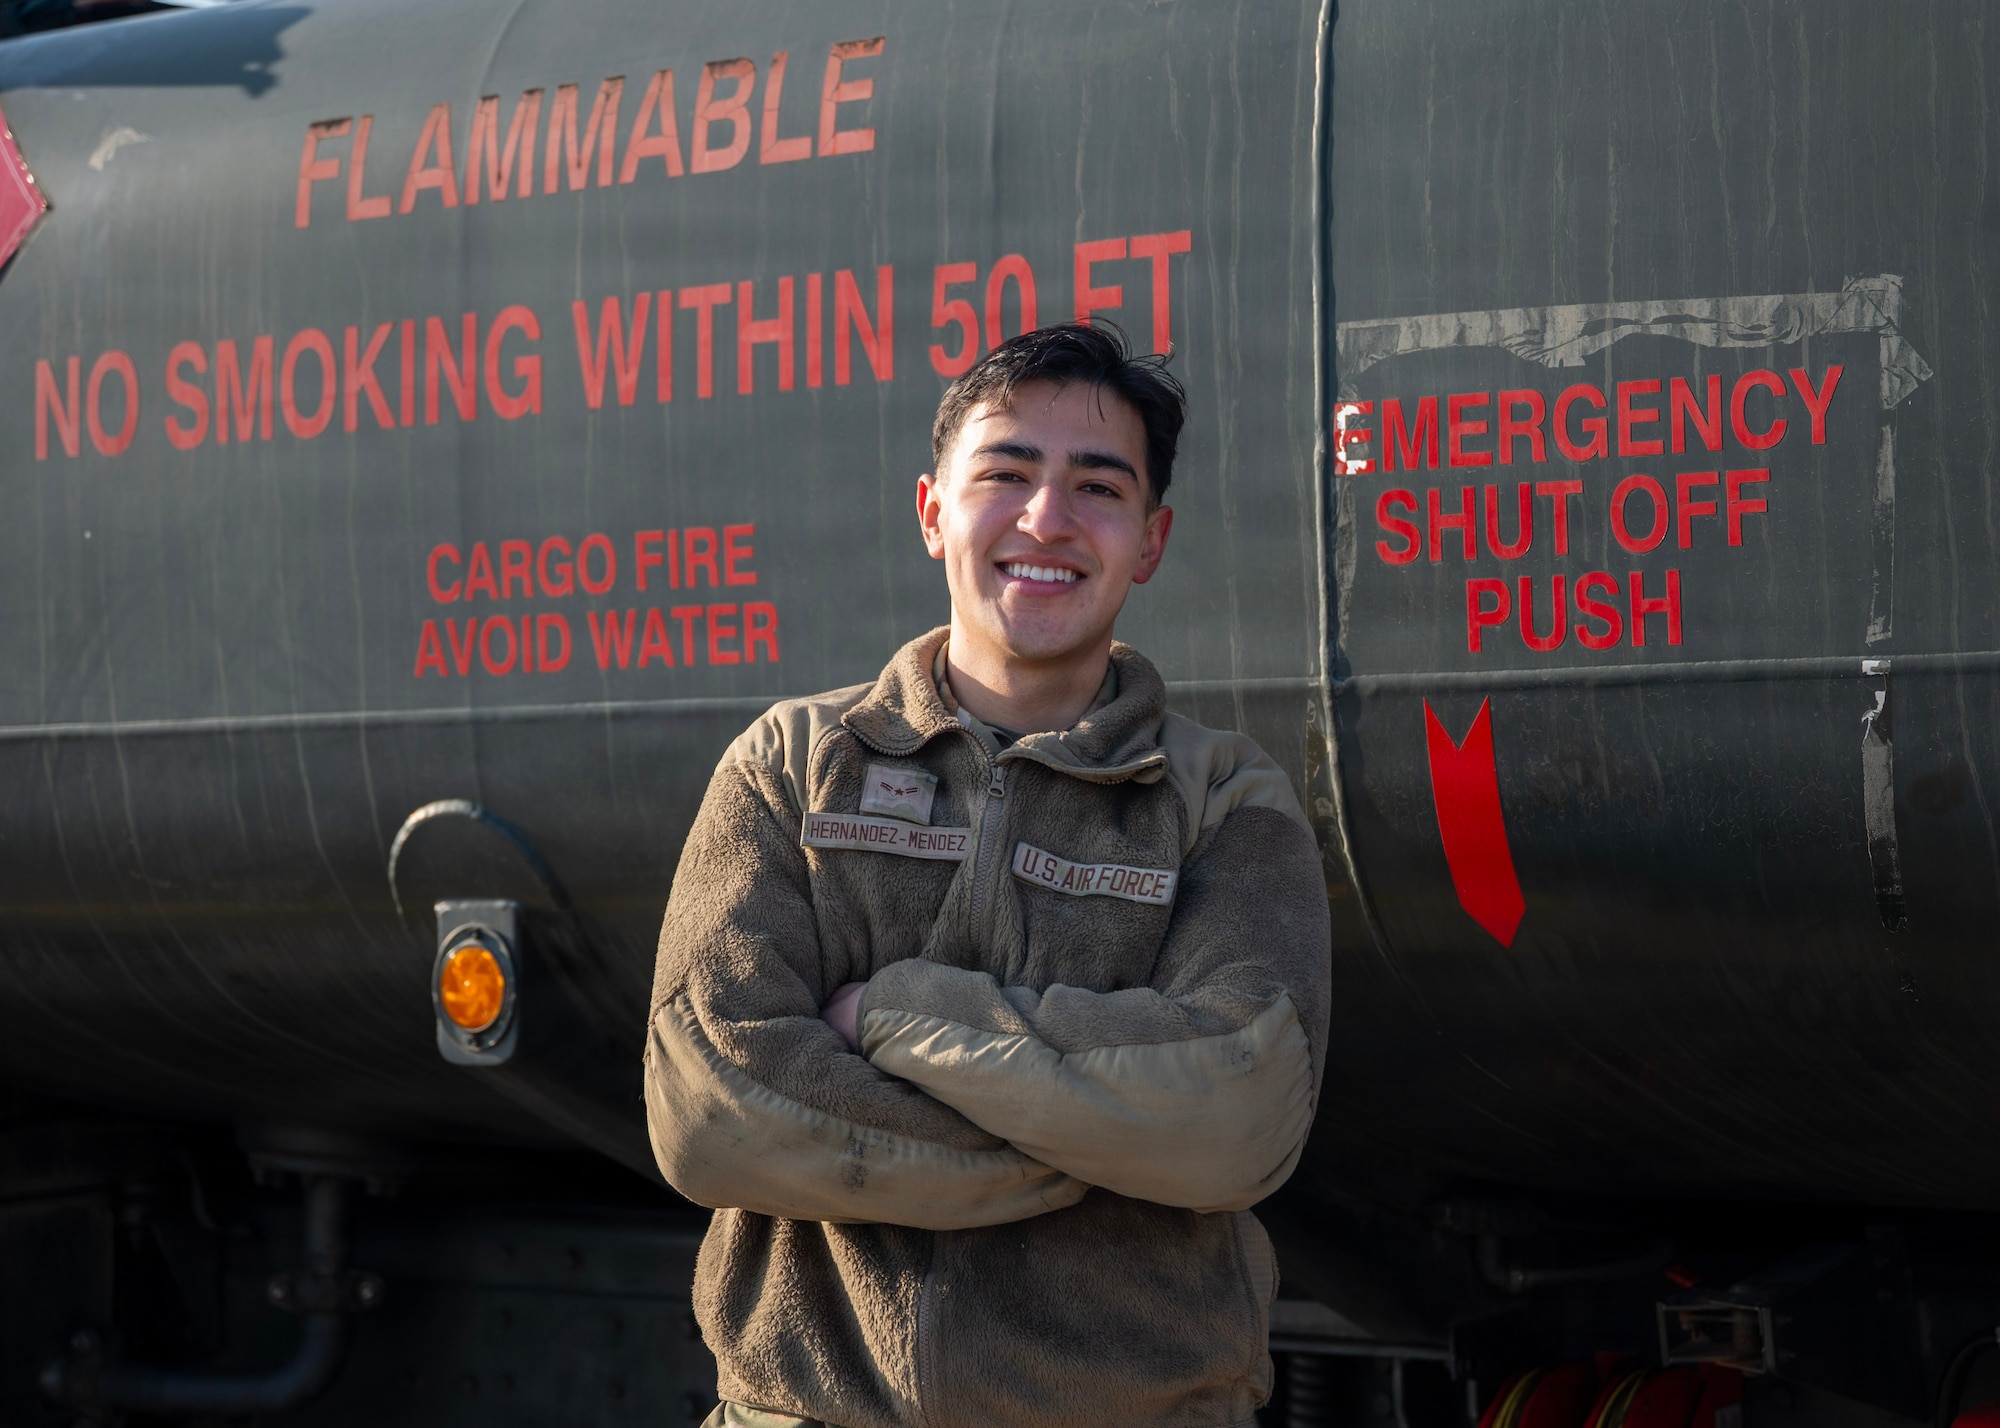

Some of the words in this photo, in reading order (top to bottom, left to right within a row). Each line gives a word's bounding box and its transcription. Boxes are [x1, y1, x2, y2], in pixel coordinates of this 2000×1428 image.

[294, 37, 885, 228] FLAMMABLE
[35, 351, 139, 461] NO
[164, 305, 542, 450] SMOKING
[572, 265, 894, 410] WITHIN
[928, 254, 1037, 378] 50
[1074, 230, 1192, 355] FT
[1333, 365, 1844, 476] EMERGENCY
[1375, 480, 1583, 566] SHUT
[1610, 468, 1771, 553] OFF
[426, 533, 617, 604] CARGO
[634, 523, 758, 591] FIRE
[414, 613, 572, 678] AVOID
[586, 601, 780, 670] WATER
[1466, 569, 1683, 653] PUSH
[809, 821, 967, 852] HERNANDEZ-MENDEZ
[1096, 867, 1169, 899] FORCE
